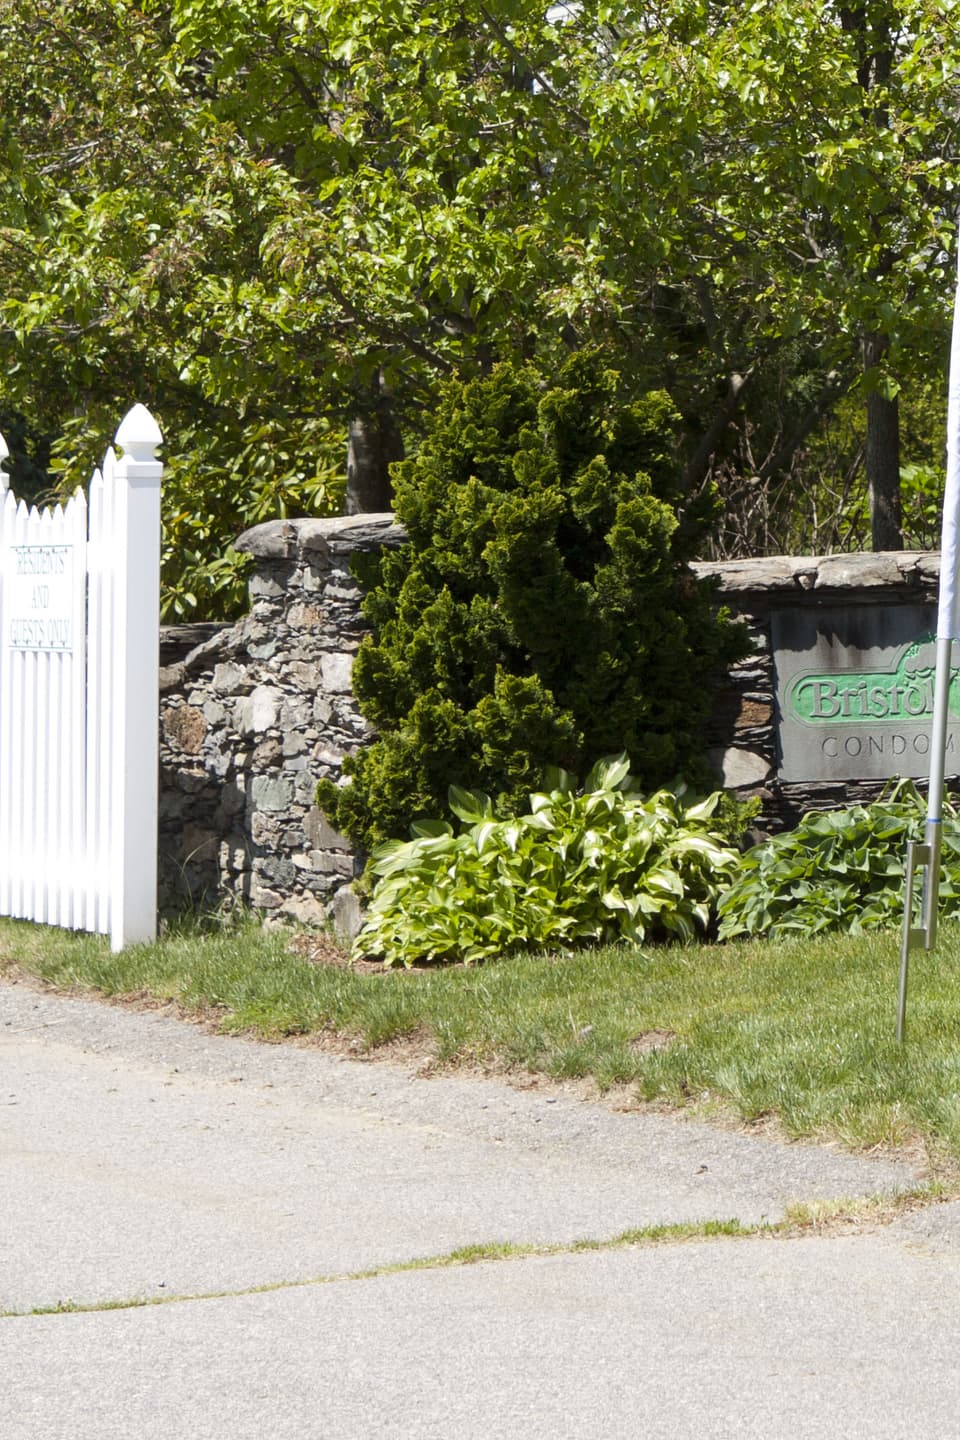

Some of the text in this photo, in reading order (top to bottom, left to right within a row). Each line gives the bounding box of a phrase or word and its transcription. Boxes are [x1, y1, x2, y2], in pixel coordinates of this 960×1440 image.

[16, 550, 65, 575] RESIDENTS
[32, 584, 50, 608] AND
[10, 618, 70, 643] GUESTS ONLY
[797, 677, 936, 718] Bristol
